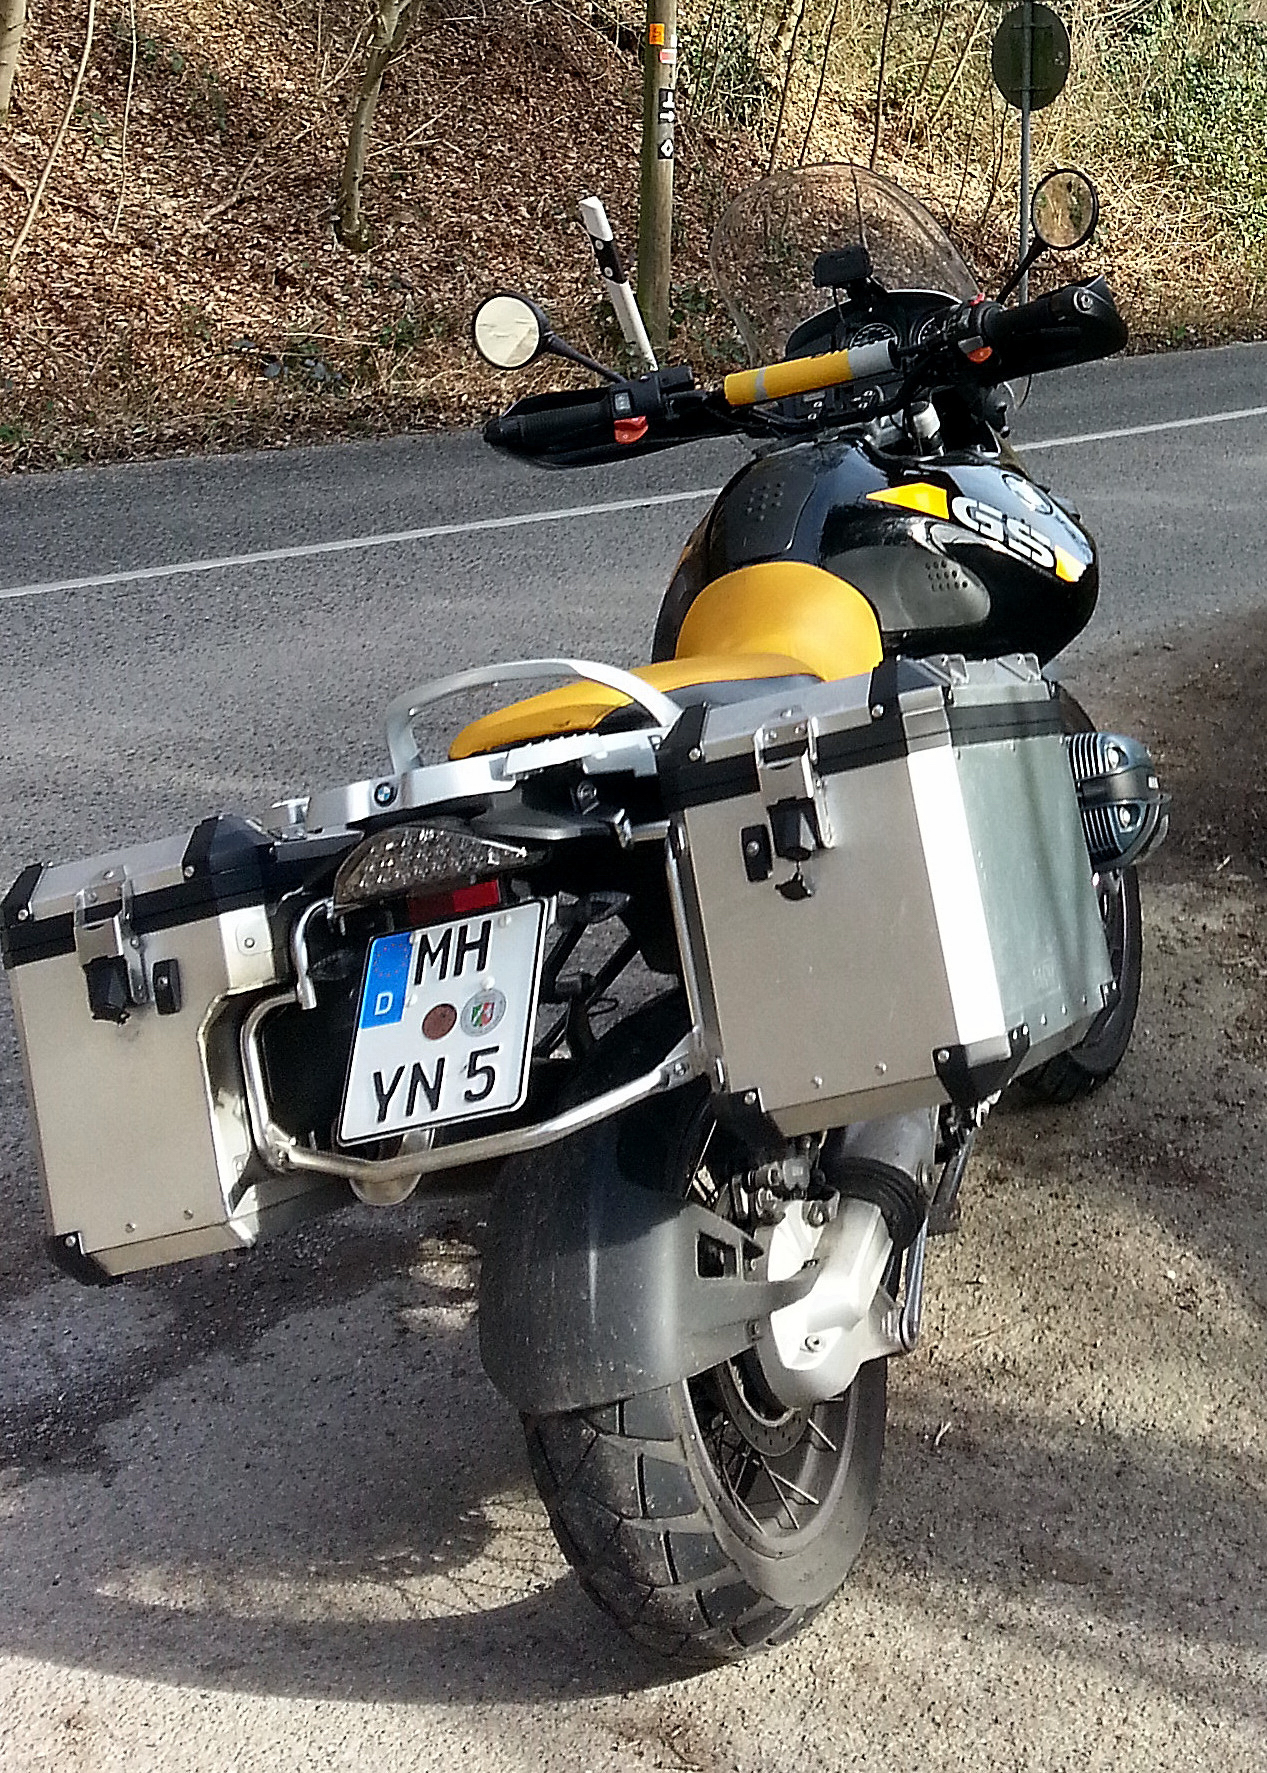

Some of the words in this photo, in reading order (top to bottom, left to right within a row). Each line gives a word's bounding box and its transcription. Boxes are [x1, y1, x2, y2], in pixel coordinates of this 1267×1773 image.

[952, 496, 1055, 568] GS
[414, 920, 492, 986] MH
[374, 991, 394, 1016] D
[373, 1057, 446, 1123] YN
[463, 1046, 500, 1102] 5
